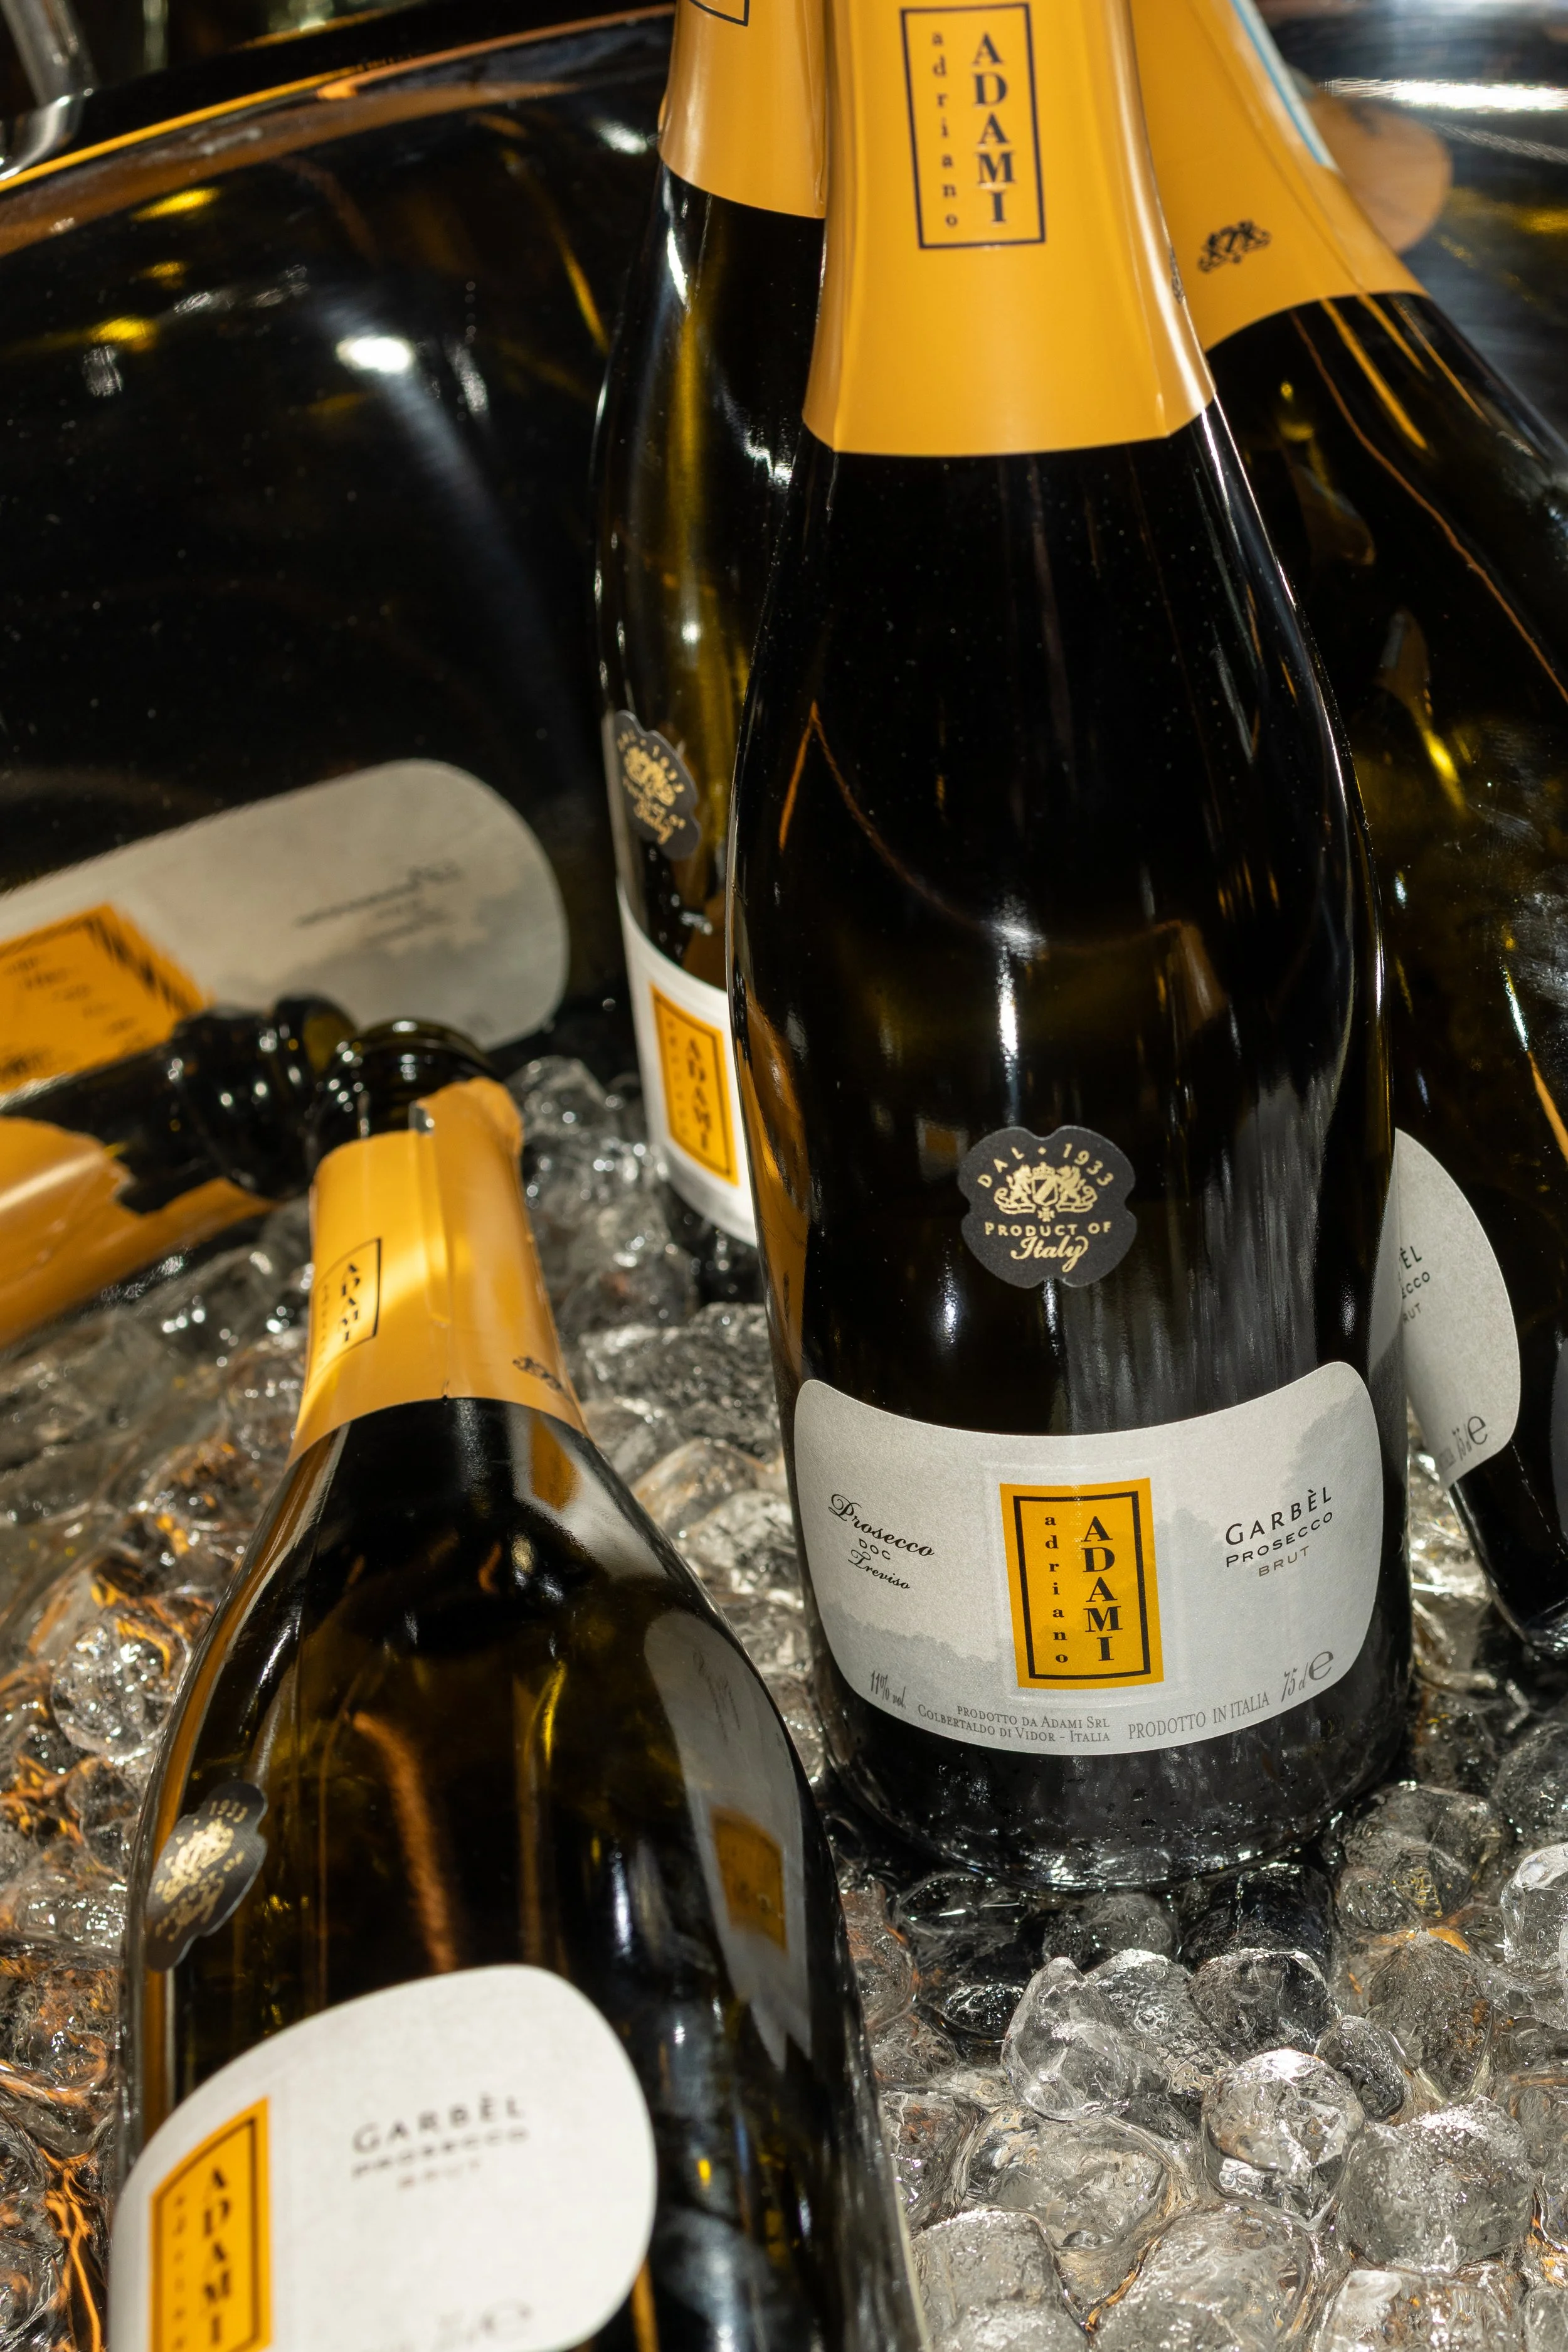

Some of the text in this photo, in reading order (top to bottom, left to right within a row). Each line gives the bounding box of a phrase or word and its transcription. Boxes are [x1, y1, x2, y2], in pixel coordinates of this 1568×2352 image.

[932, 31, 959, 228] adriano
[972, 31, 1016, 224] ADAMI
[977, 1143, 1115, 1188] DAL 1933
[984, 1221, 1112, 1237] PRODUCT OF
[1010, 1235, 1089, 1272] Italy
[828, 1494, 935, 1556] Prosecco
[1226, 1486, 1332, 1545] GARBÈL
[859, 1538, 891, 1560] DOC
[1226, 1512, 1333, 1568] PROSECCO
[1259, 1545, 1310, 1577] BRUT
[847, 1549, 911, 1589] Treviso
[1044, 1516, 1069, 1663] adriano
[1081, 1516, 1123, 1661] ADAMI
[871, 1670, 889, 1701] 11%
[1281, 1668, 1298, 1703] 75
[918, 1704, 996, 1736] COLBERTALDO
[1000, 1728, 1012, 1738] DI
[1015, 1727, 1056, 1742] VIDOR
[1070, 1730, 1110, 1742] ITALIA
[956, 1705, 1018, 1725] PRODOTTO
[1022, 1716, 1037, 1727] DA
[1041, 1715, 1083, 1728] ADAMI
[1128, 1691, 1270, 1740] PRODOTTO IN ITALIA
